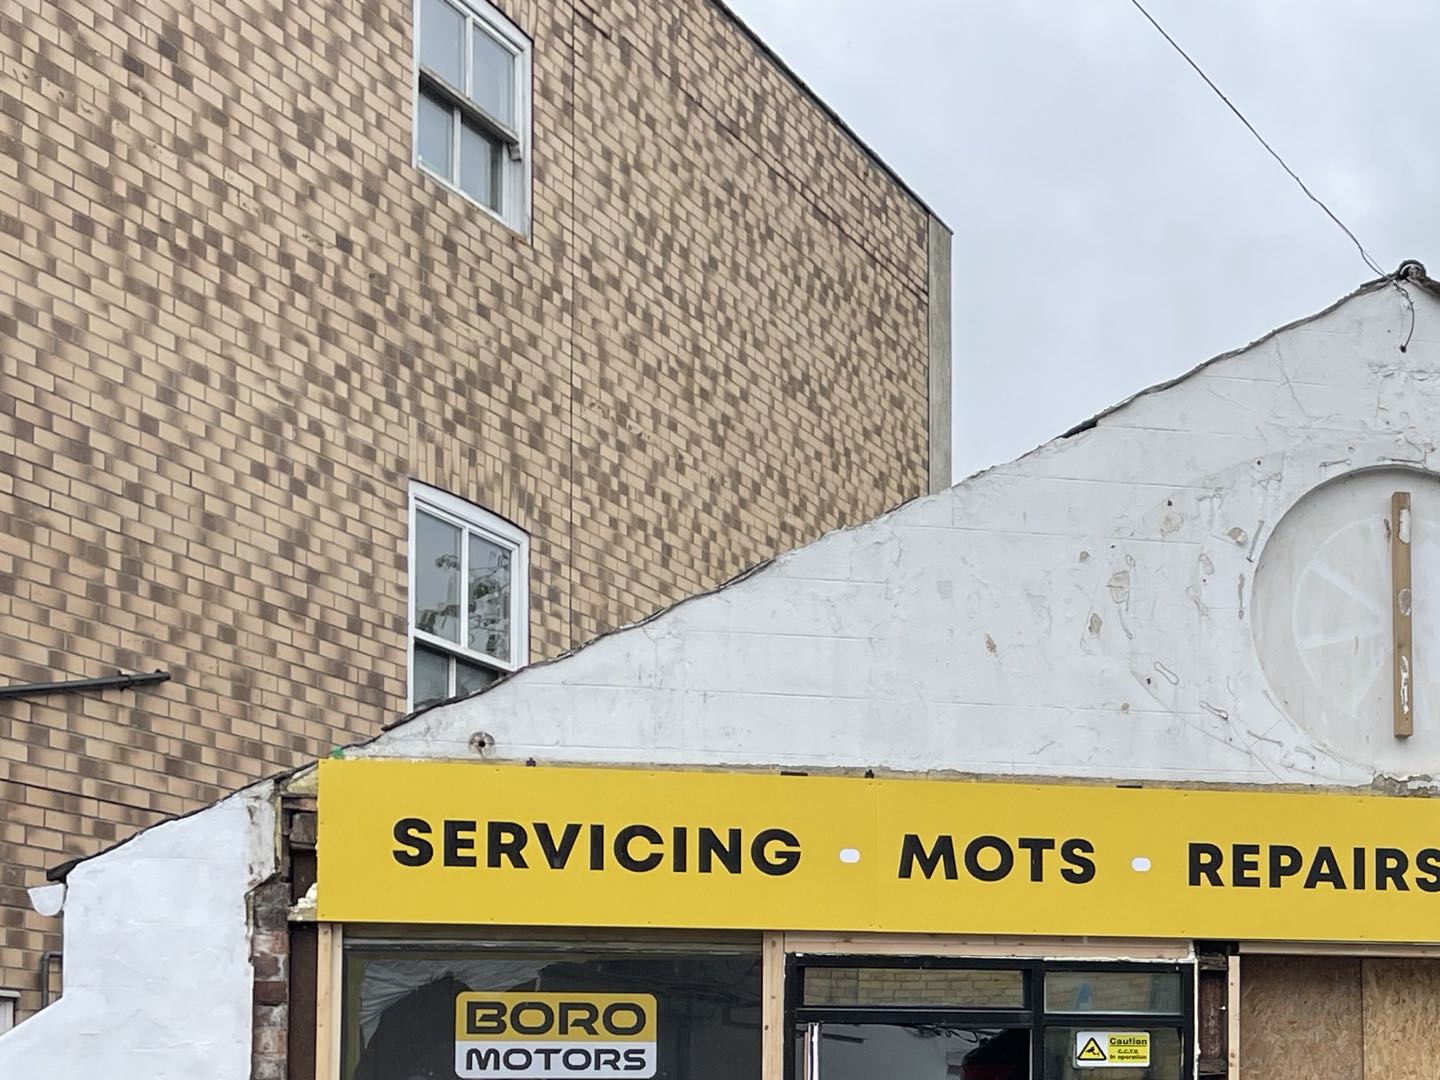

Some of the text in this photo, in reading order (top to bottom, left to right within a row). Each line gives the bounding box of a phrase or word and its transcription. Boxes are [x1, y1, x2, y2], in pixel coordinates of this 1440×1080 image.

[393, 817, 802, 877] SERVICING
[897, 833, 1097, 885] MOTS
[466, 1001, 647, 1036] BORO
[1110, 1037, 1147, 1045] Caution
[465, 1048, 647, 1071] MOTORS
